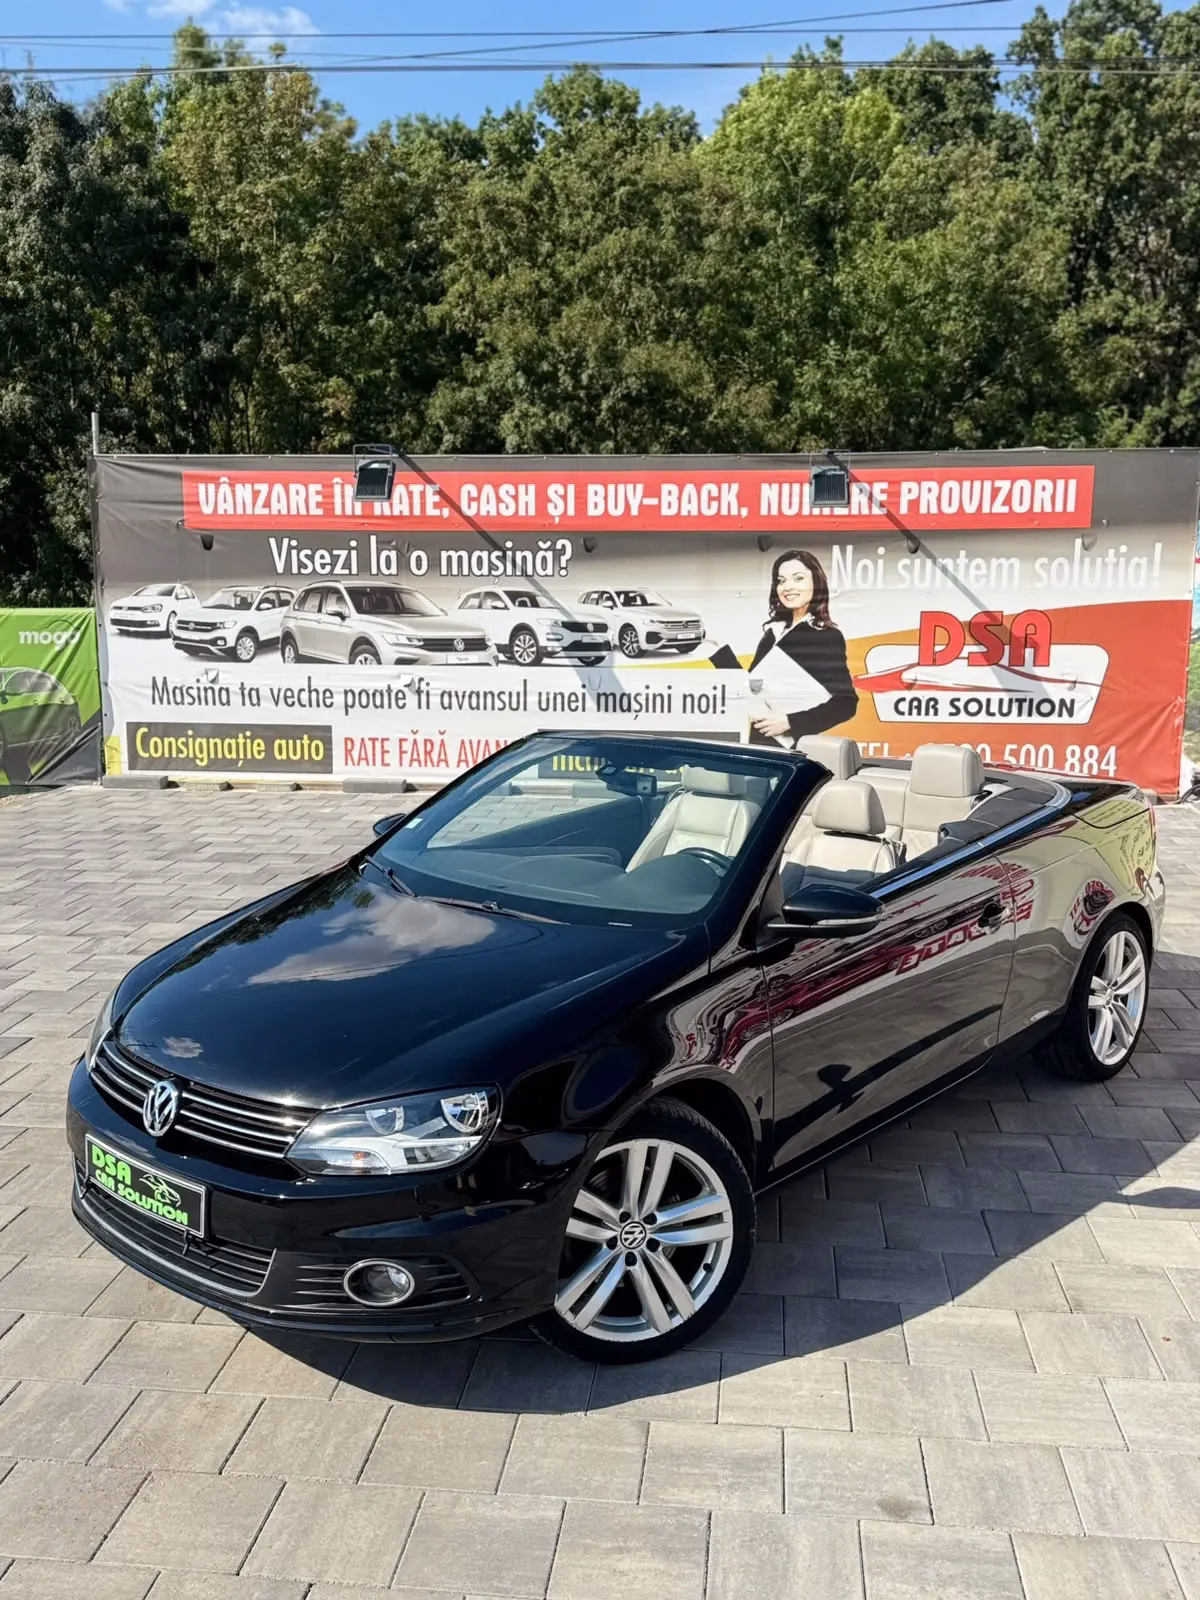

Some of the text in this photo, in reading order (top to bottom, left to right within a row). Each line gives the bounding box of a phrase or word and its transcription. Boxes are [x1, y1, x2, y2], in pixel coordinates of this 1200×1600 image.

[198, 477, 324, 515] VÂNZARE
[460, 483, 536, 516] CASH
[547, 483, 576, 524] ȘI
[587, 482, 748, 519] BUY-BACK,
[760, 482, 889, 516] NURE
[900, 479, 1077, 514] PROVIZORII
[268, 534, 573, 584] Visezi la o mașină?
[831, 544, 886, 589] Noi
[897, 550, 1020, 589] suntem
[918, 609, 1052, 667] DSA
[239, 681, 260, 707] ta
[269, 676, 334, 708] veche
[344, 684, 407, 716] poate
[415, 677, 431, 710] fi
[440, 679, 527, 712] avansul
[538, 684, 587, 713] unei
[596, 685, 672, 720] mașini
[682, 684, 726, 715] noi!
[893, 697, 1075, 718] CAR SOLUTION
[136, 727, 324, 767] Consignație auto
[344, 737, 391, 767] RATE
[399, 728, 449, 768] FĂRĂ
[1003, 743, 1054, 768] 500
[1065, 744, 1117, 777] 884
[91, 1144, 131, 1186] DSA
[117, 1183, 188, 1225] SOLUTION
